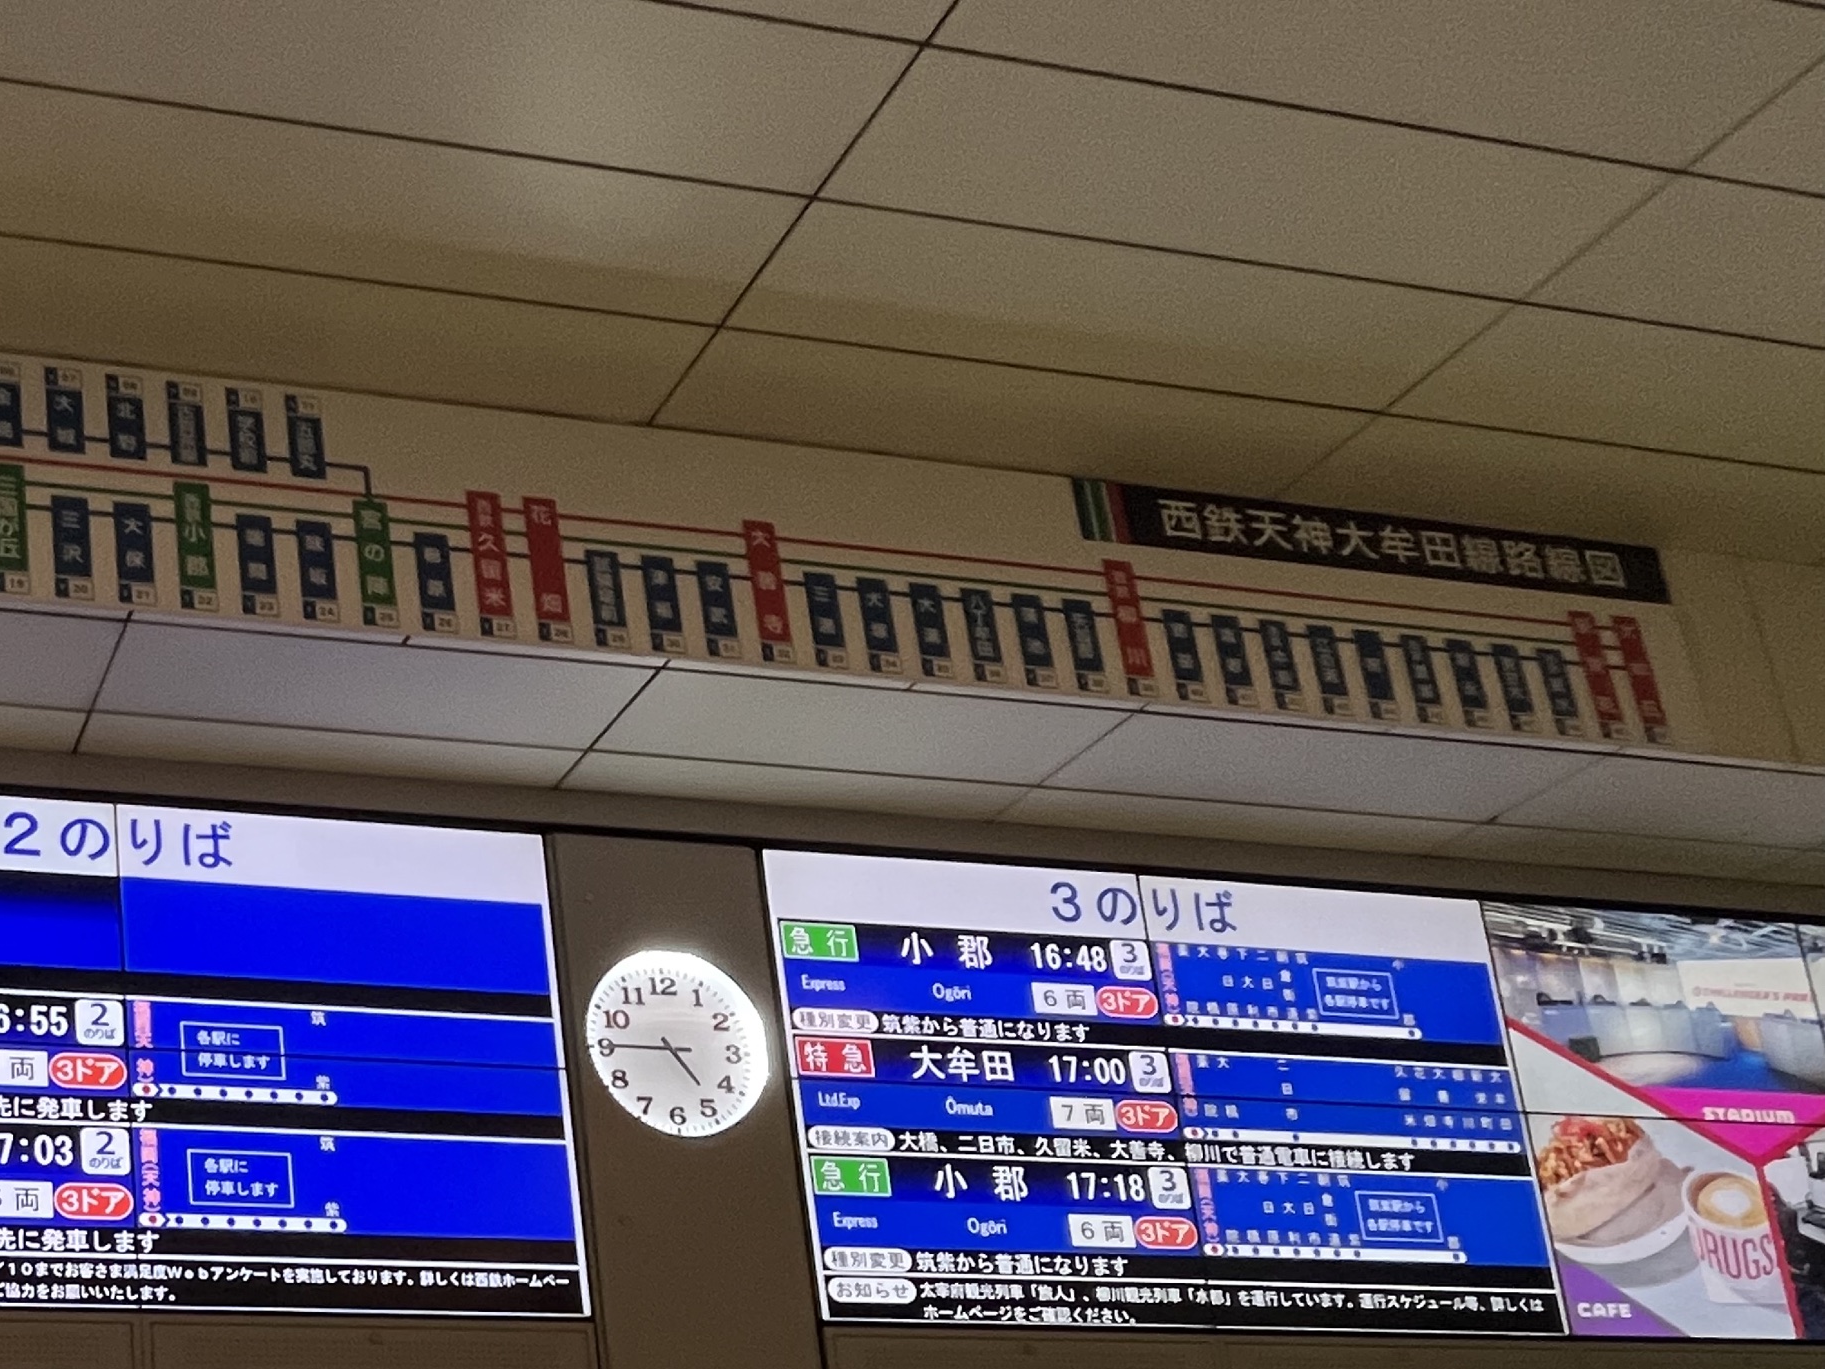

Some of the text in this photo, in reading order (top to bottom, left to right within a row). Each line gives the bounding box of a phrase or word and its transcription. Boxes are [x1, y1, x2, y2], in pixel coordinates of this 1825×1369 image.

[1158, 496, 1627, 588] 西鉄天神大牟田線路線図
[788, 927, 850, 958] 急行
[900, 931, 994, 971] 小郡
[1122, 941, 1139, 964] 3
[1029, 941, 1109, 974] 16:48
[648, 976, 678, 997] 12
[801, 973, 847, 993] Express
[621, 986, 646, 1006] 11
[692, 988, 704, 1008] 1
[1102, 991, 1154, 1015] 3ドア
[89, 1003, 111, 1026] 2
[602, 1009, 630, 1029] 10
[711, 1012, 731, 1032] 2
[881, 1013, 1091, 1043] 筑紫から普通になります
[597, 1037, 615, 1058] 9
[725, 1044, 742, 1065] 3
[803, 1042, 869, 1072] 特急
[57, 1057, 122, 1084] 3ドア
[909, 1045, 1015, 1083] 大牟田
[1047, 1055, 1127, 1087] 17:00
[1140, 1053, 1158, 1076] 3
[611, 1069, 629, 1090] 8
[717, 1074, 735, 1095] 4
[636, 1096, 653, 1116] 7
[669, 1106, 687, 1126] 6
[700, 1099, 718, 1118] 5
[1121, 1105, 1174, 1130] 3ドア
[1701, 1105, 1797, 1124] STADIUM
[95, 1130, 116, 1156] 2
[819, 1161, 884, 1193] 急行
[934, 1162, 1030, 1204] 小郡
[1065, 1170, 1146, 1204] 17:18
[1160, 1169, 1178, 1191] 3
[60, 1186, 128, 1215] 3ドア
[832, 1211, 879, 1230] Express
[1140, 1222, 1194, 1247] 3ドア
[835, 1280, 910, 1300] お知らせ
[1576, 1301, 1632, 1319] CAFE
